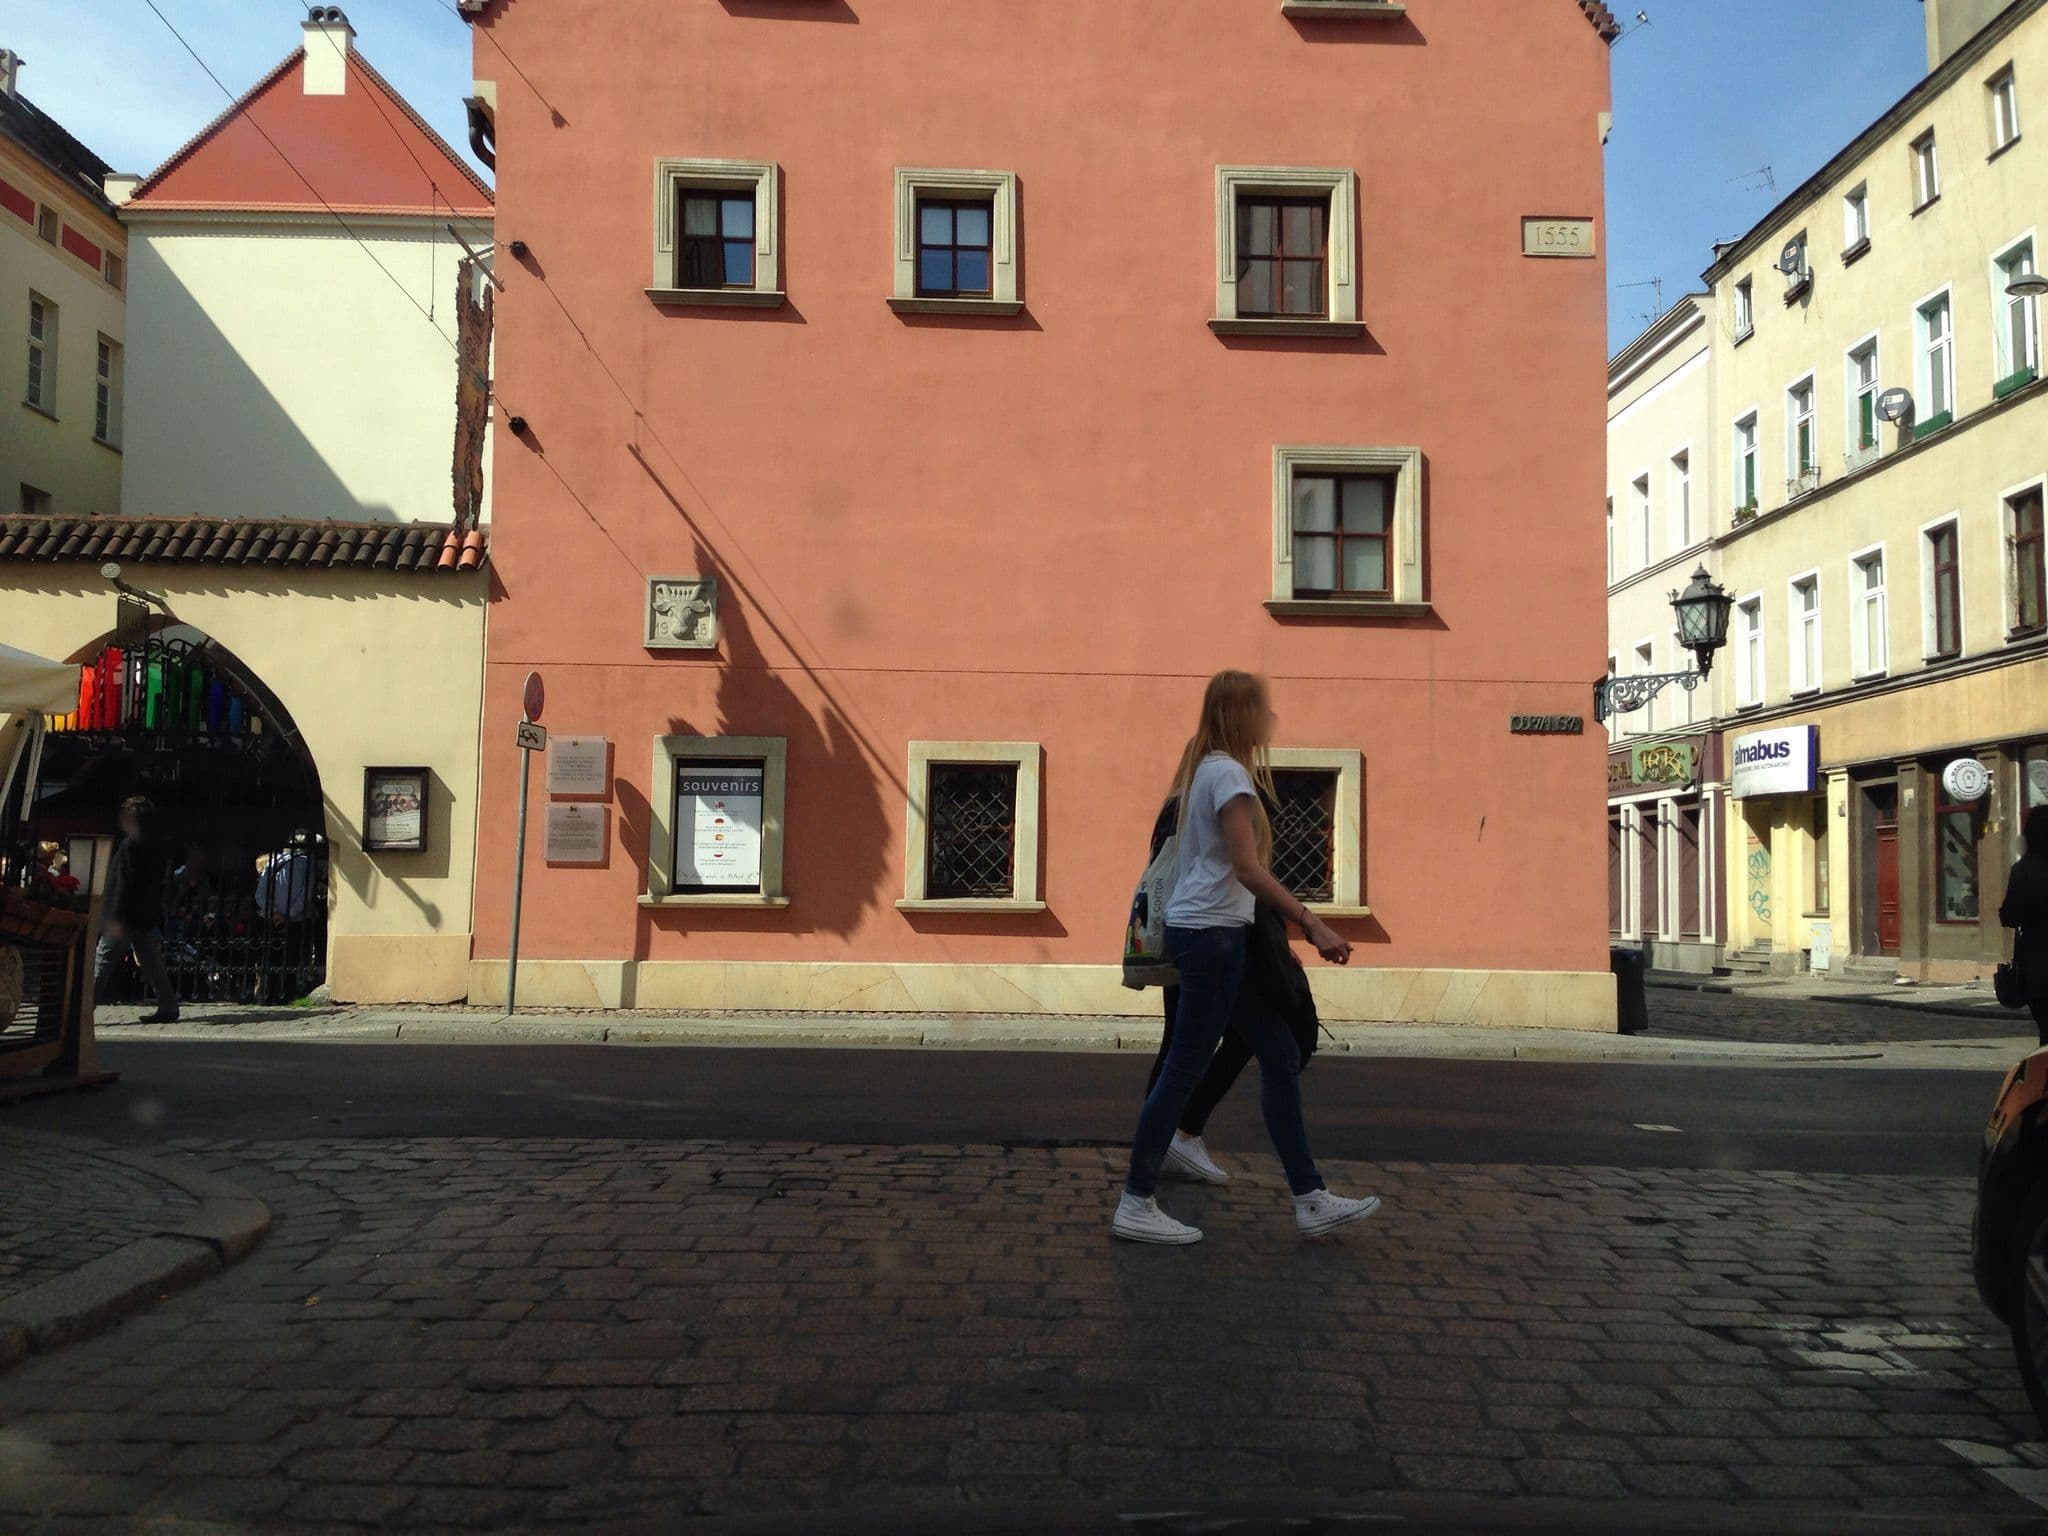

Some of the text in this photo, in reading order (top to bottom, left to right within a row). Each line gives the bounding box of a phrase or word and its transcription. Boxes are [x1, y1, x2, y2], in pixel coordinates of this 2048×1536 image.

[1536, 226, 1580, 246] 1555
[1735, 739, 1791, 766] almabus
[683, 779, 759, 792] souvenirs
